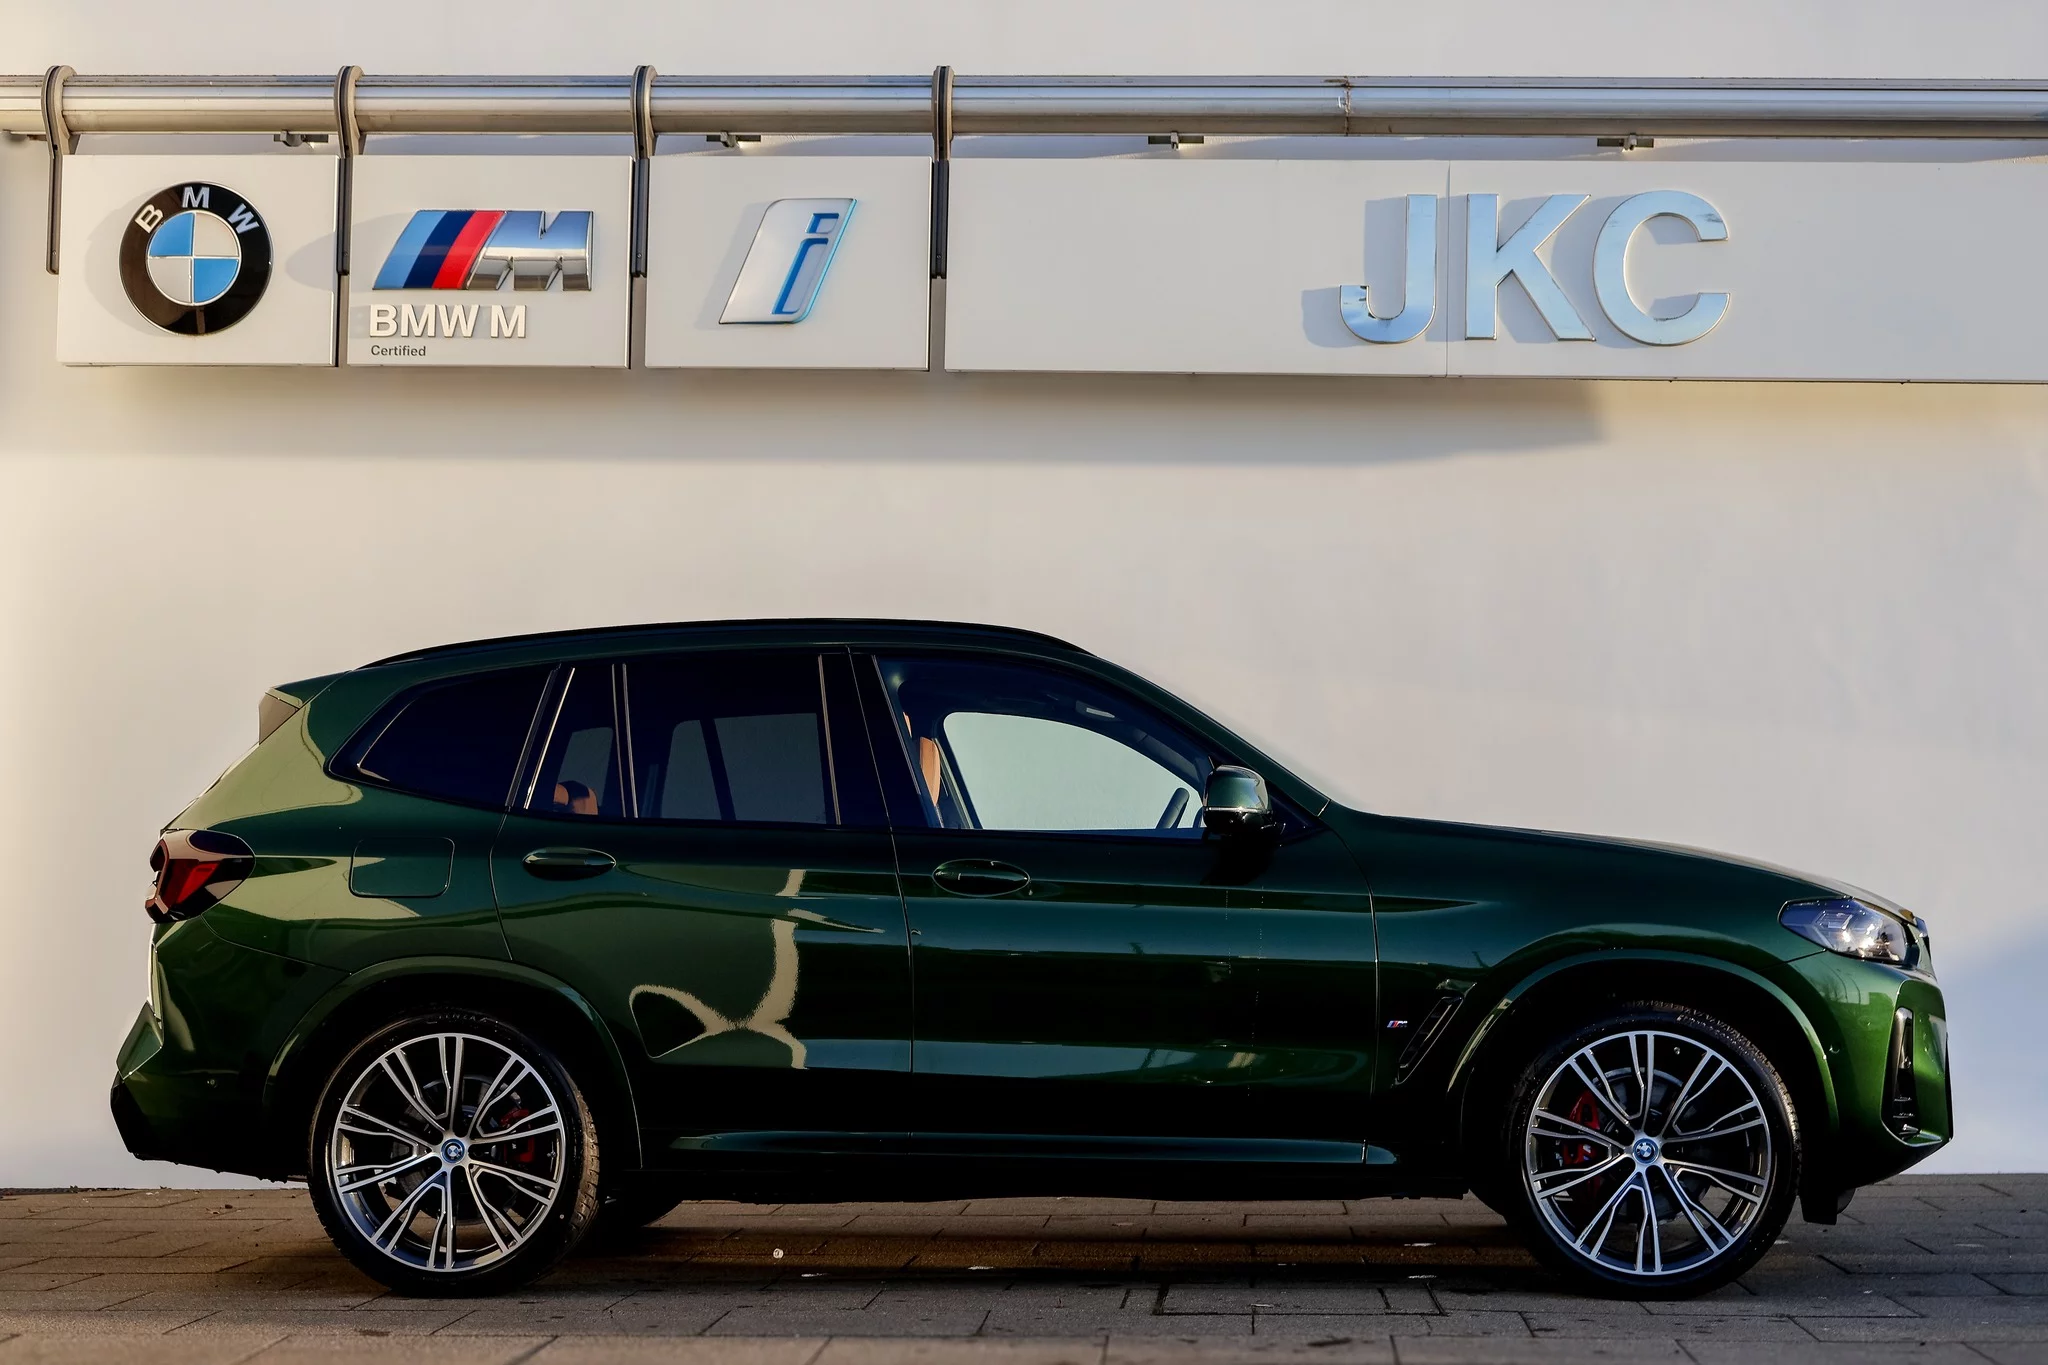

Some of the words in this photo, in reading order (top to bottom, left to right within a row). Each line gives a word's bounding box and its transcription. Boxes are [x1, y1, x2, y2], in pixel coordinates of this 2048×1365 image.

[134, 186, 260, 235] BMW
[1339, 189, 1731, 347] JKC
[369, 303, 480, 339] BMW
[490, 304, 527, 339] M
[370, 344, 427, 357] Certified
